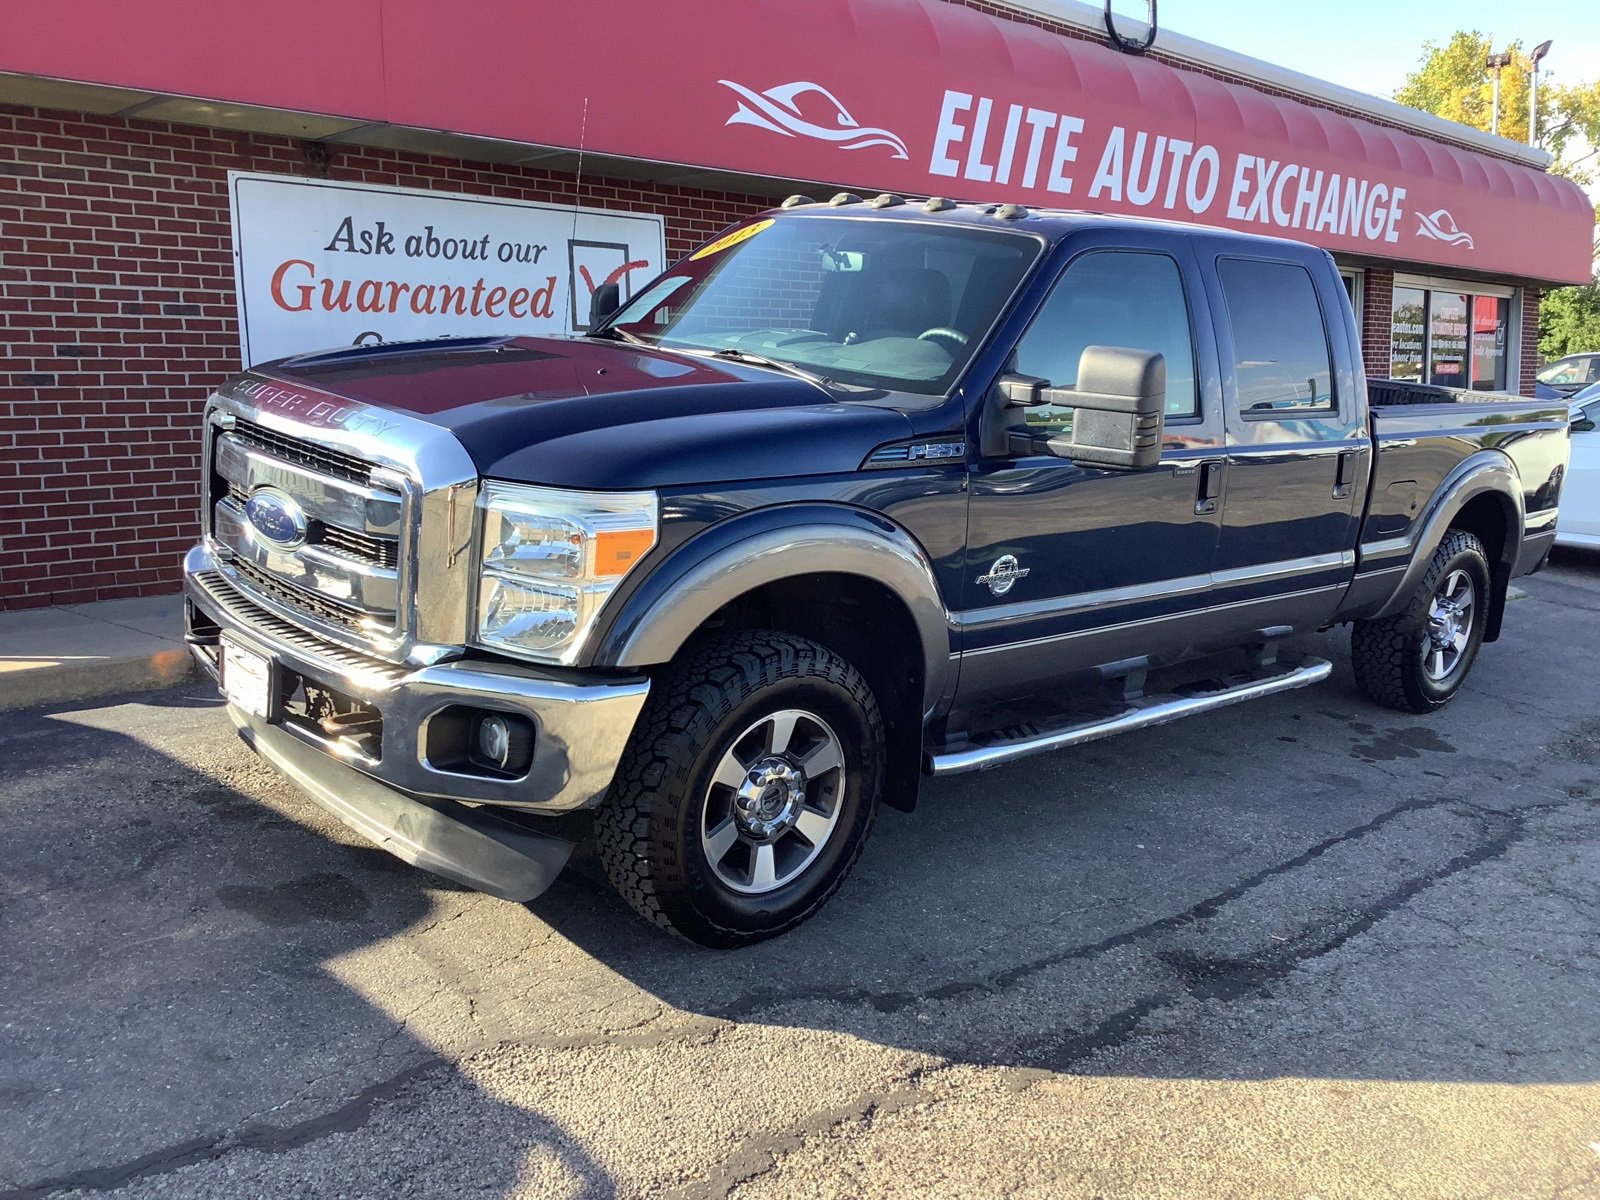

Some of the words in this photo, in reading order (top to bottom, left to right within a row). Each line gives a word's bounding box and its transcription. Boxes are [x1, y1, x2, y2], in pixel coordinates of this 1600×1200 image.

[929, 90, 1085, 195] ELITE
[1088, 126, 1220, 214] AUTO
[1227, 154, 1407, 243] EXCHANGE
[324, 215, 396, 256] Ask
[405, 226, 489, 261] about
[498, 241, 547, 265] our
[270, 259, 557, 319] Guaranteed
[233, 379, 307, 411] SUPER
[306, 401, 400, 437] DUTY
